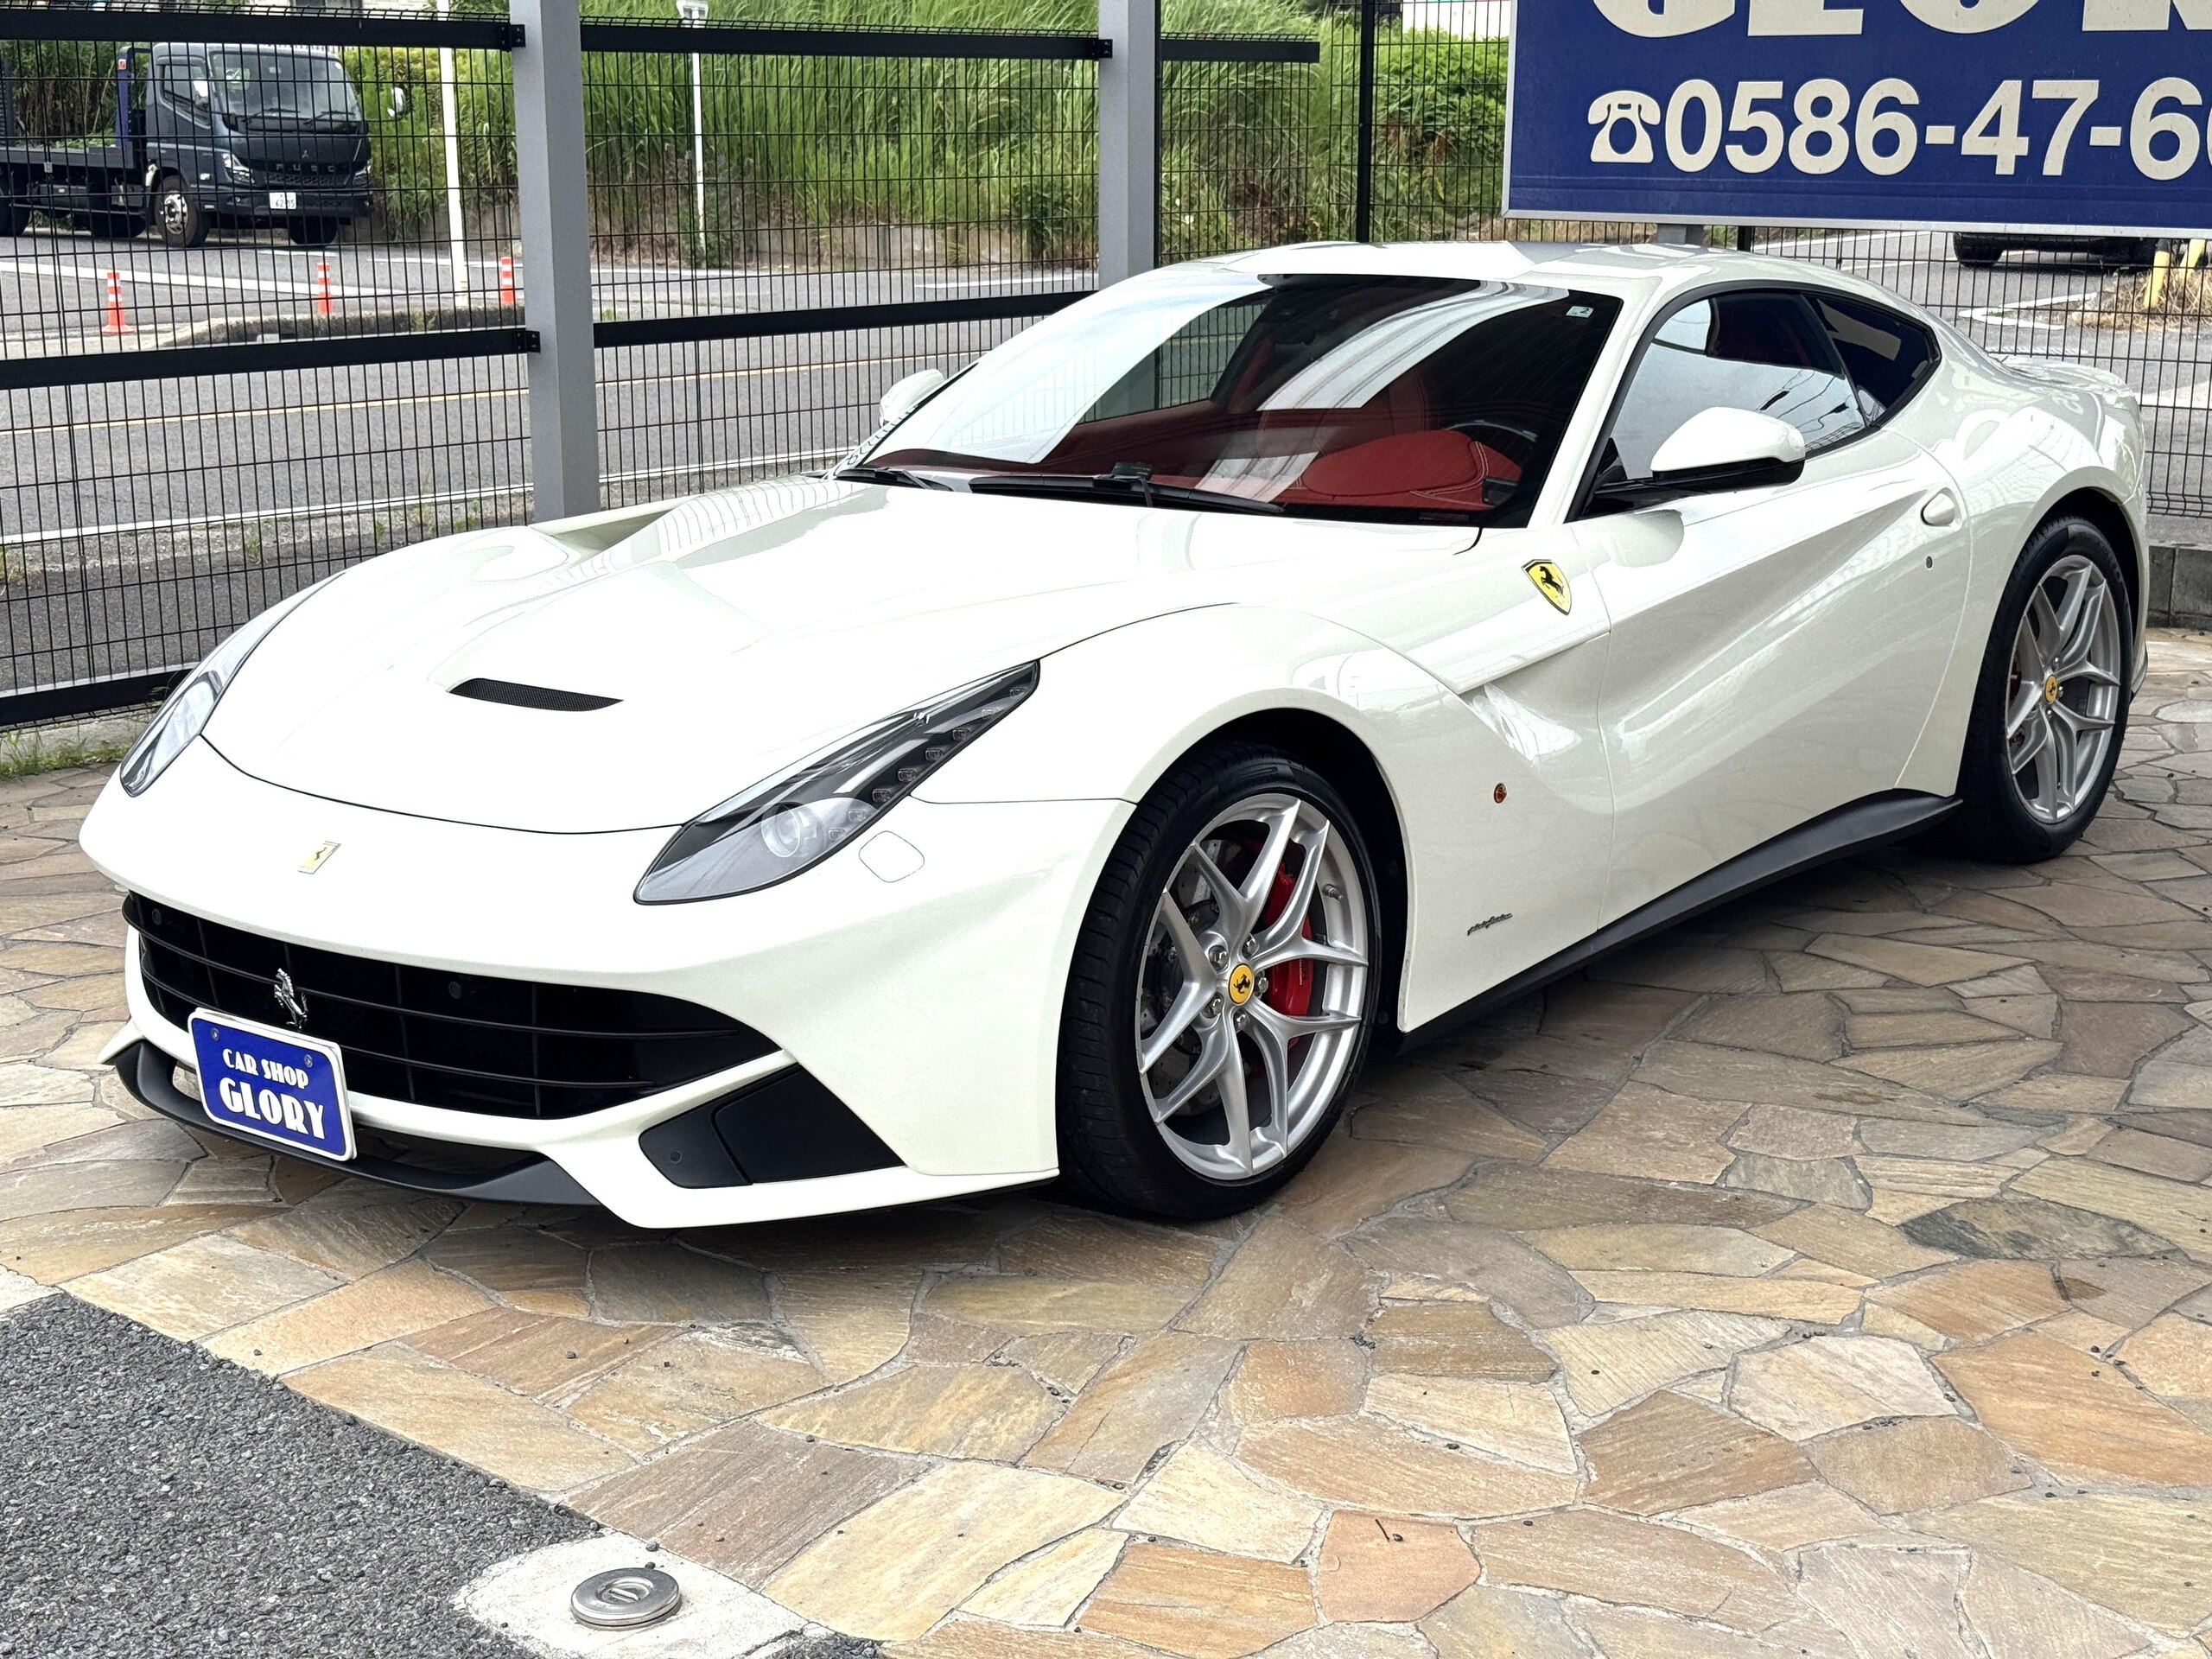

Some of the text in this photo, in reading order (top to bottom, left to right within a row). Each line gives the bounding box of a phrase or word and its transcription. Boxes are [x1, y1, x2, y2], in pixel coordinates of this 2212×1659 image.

[1665, 76, 2212, 181] 0586-47-6
[222, 1048, 309, 1090] CAR SHOP
[219, 1077, 326, 1140] GLORY
